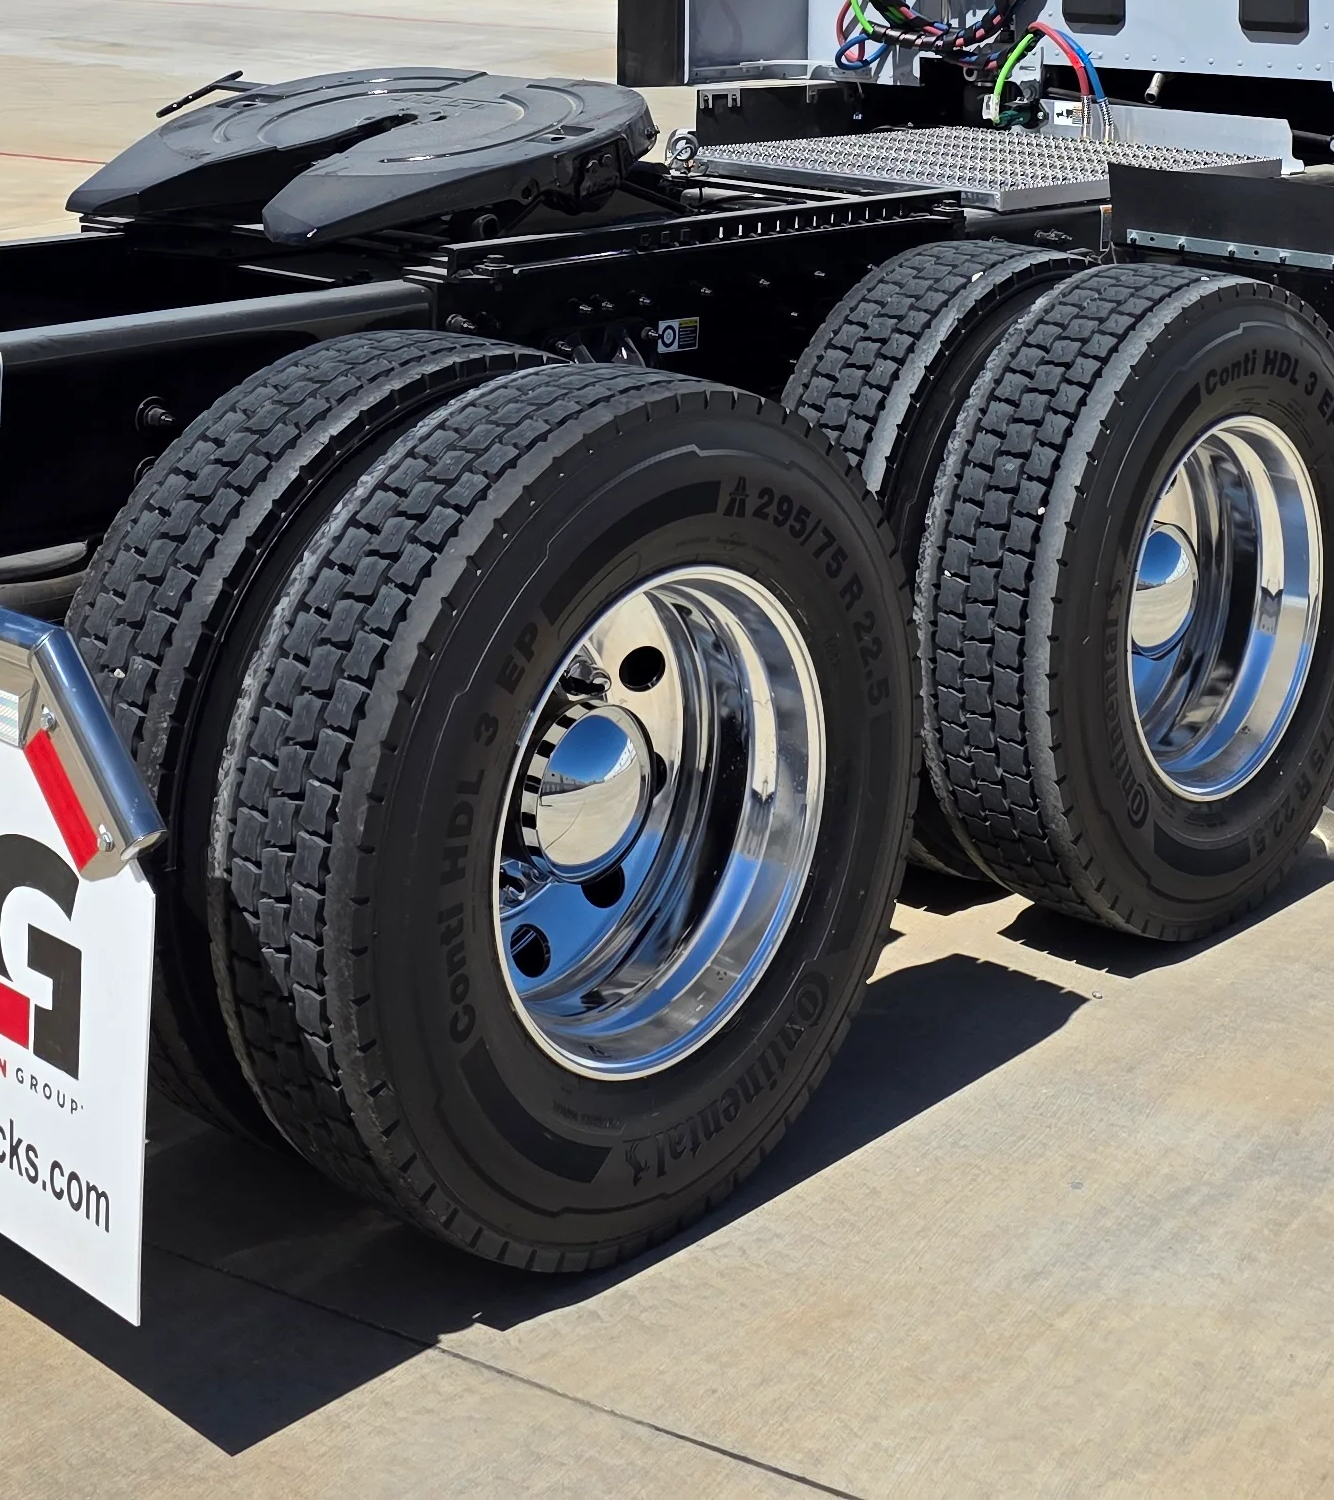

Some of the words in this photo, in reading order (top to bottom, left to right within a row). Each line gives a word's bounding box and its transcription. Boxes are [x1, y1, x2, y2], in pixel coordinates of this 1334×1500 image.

[1205, 349, 1258, 396] Conti
[1261, 349, 1299, 386] HDL
[1304, 371, 1318, 396] 3
[751, 486, 849, 579] 295/75
[839, 572, 865, 613] R
[852, 610, 890, 706] 22.5
[496, 621, 540, 695] EP
[474, 711, 500, 748] 3
[1103, 619, 1149, 829] Continental
[439, 768, 485, 887] HDL
[1293, 771, 1313, 797] R
[436, 907, 477, 1045] Conti
[15, 1067, 79, 1116] GROUP
[653, 970, 831, 1179] Continental
